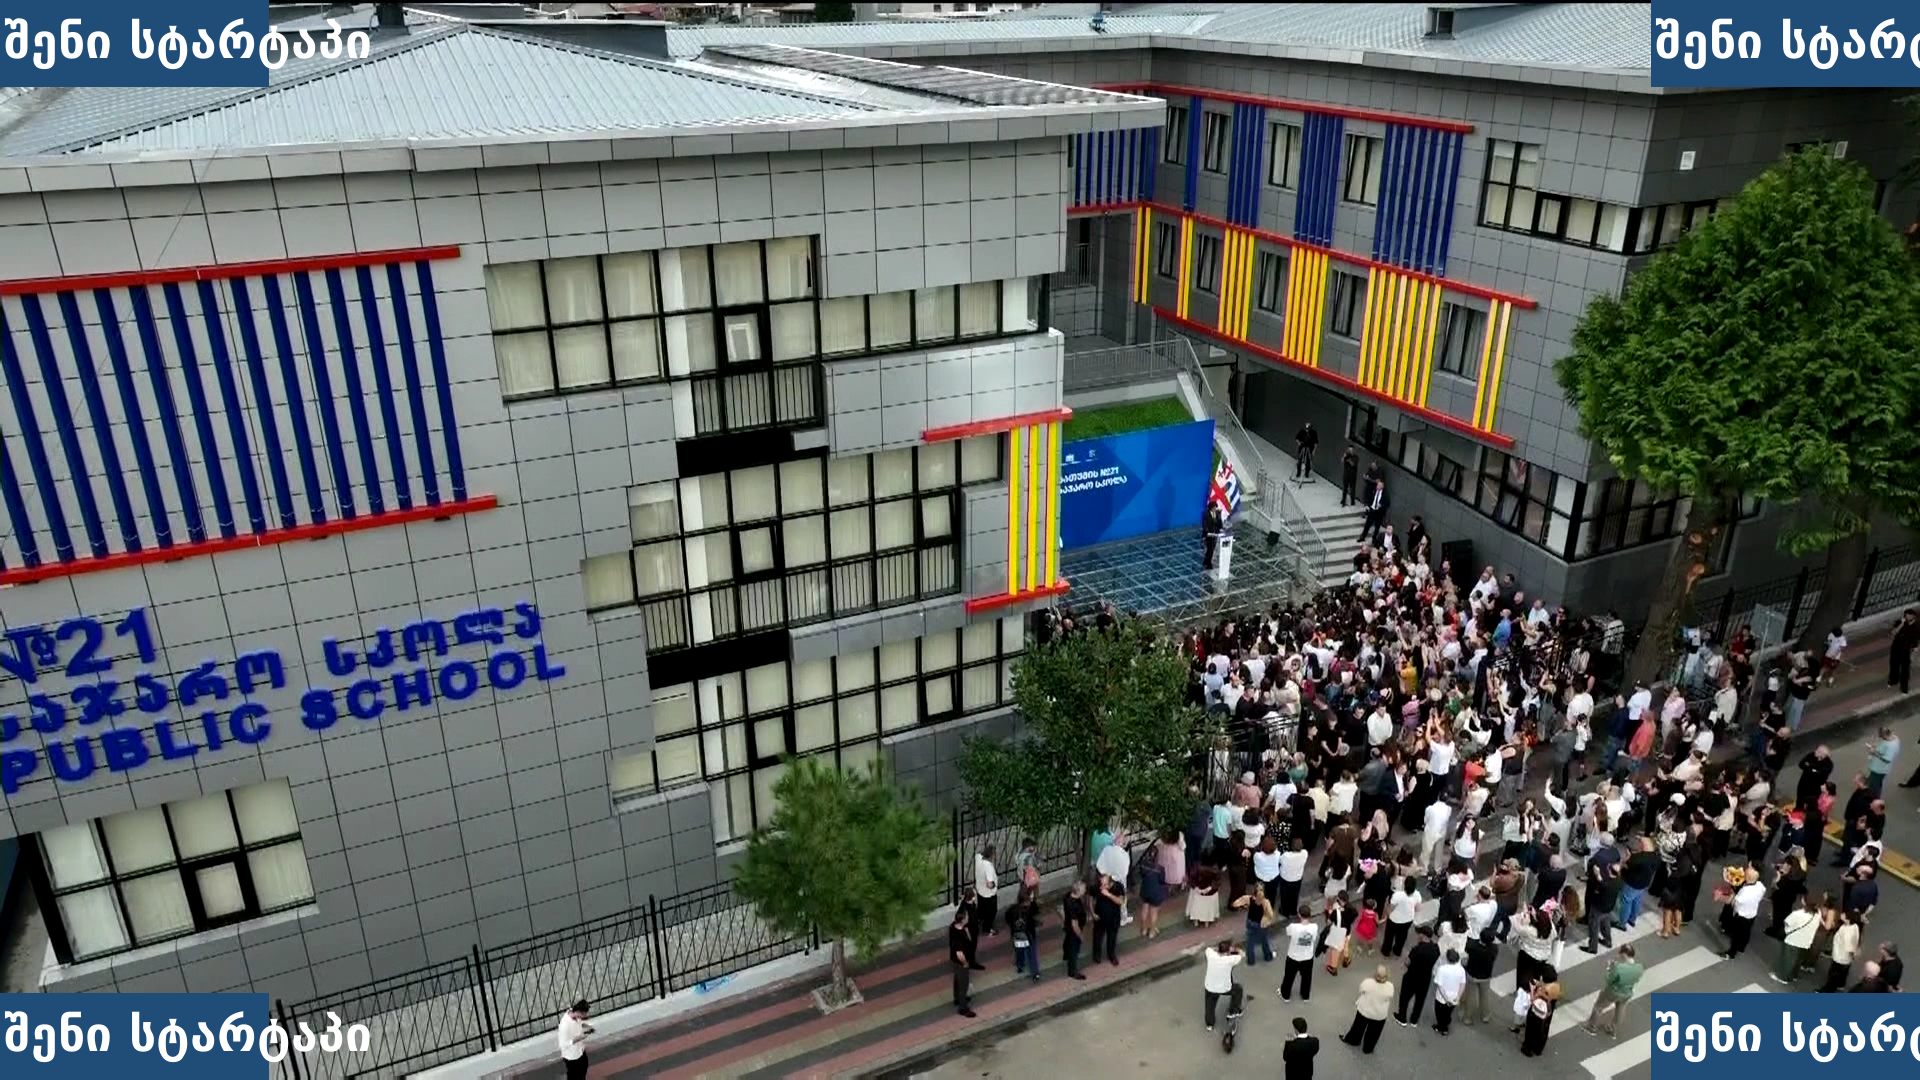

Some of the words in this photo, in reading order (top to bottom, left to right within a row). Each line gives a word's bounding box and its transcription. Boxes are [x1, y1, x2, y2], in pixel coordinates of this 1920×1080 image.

[322, 602, 543, 676] სკოლა
[0, 702, 272, 794] PUBLIC
[301, 643, 566, 730] SCHOOL
